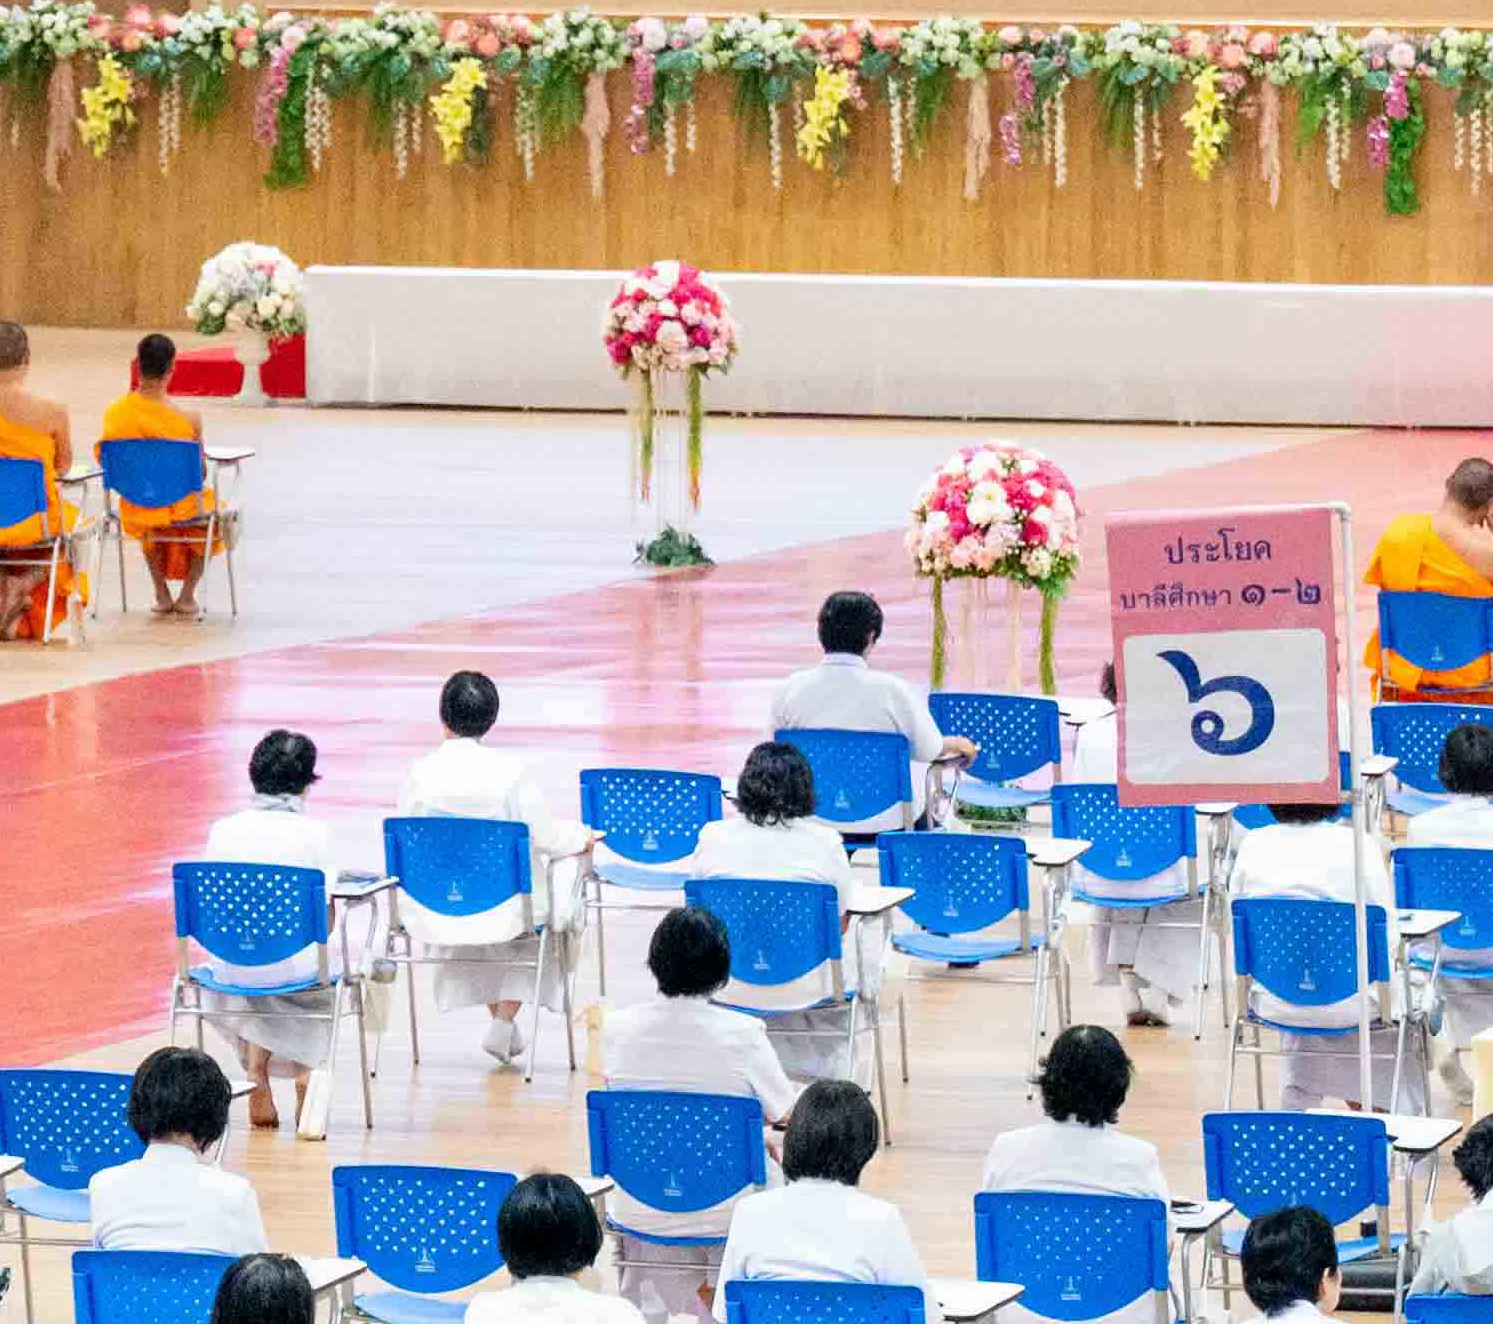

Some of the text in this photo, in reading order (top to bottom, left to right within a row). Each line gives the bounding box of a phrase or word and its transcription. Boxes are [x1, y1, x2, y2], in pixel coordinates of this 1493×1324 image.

[1165, 528, 1272, 565] ประโยค
[1119, 581, 1232, 610] บาลีศึกษา
[1155, 649, 1276, 757] ๖
